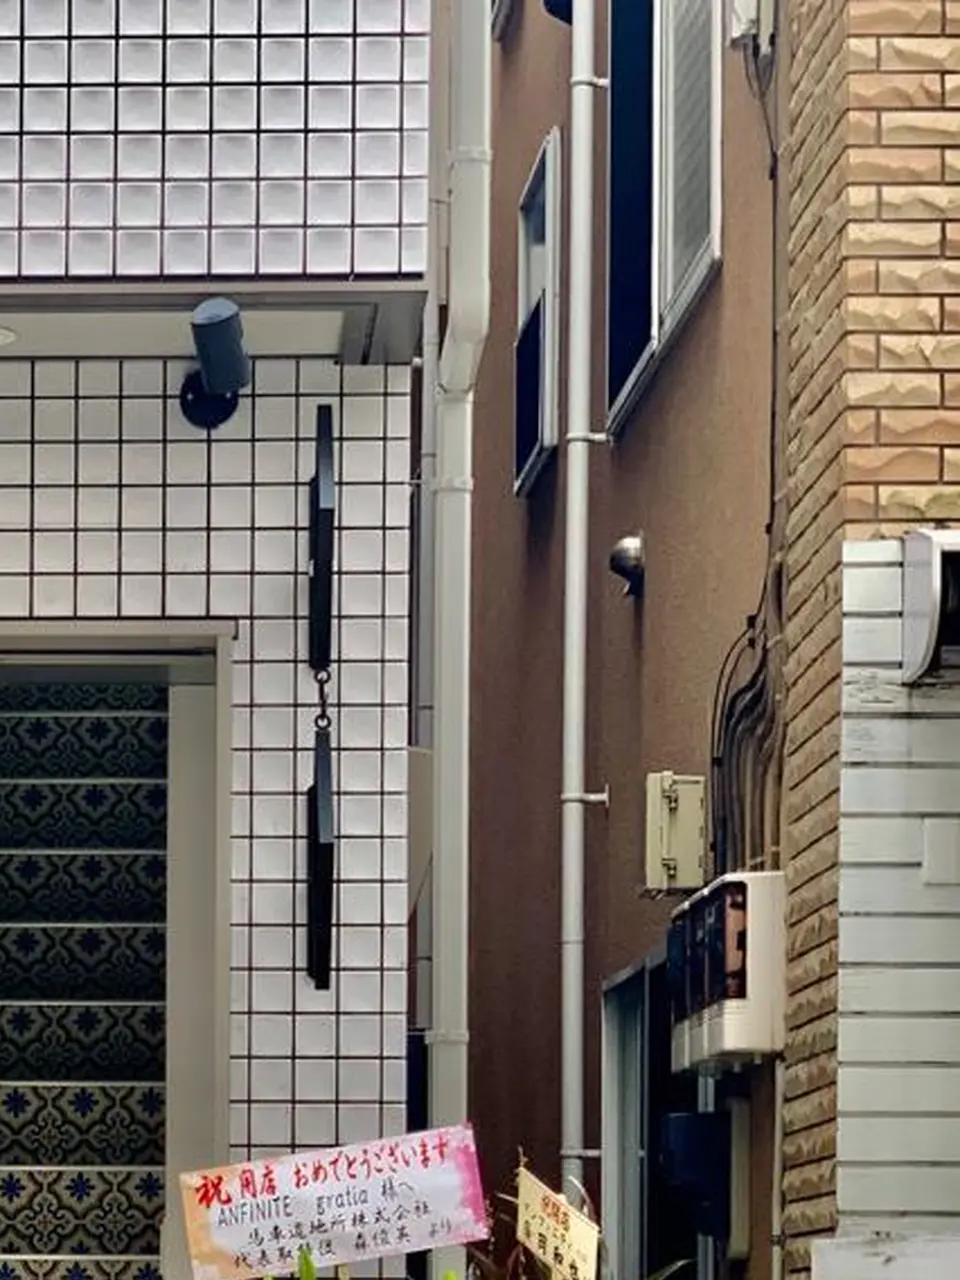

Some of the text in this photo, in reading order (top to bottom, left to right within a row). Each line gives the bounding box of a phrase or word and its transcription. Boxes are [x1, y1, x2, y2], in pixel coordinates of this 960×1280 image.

[293, 1134, 450, 1190] おめでとうございます
[218, 1196, 294, 1228] ANFINITE
[316, 1187, 369, 1215] gratia
